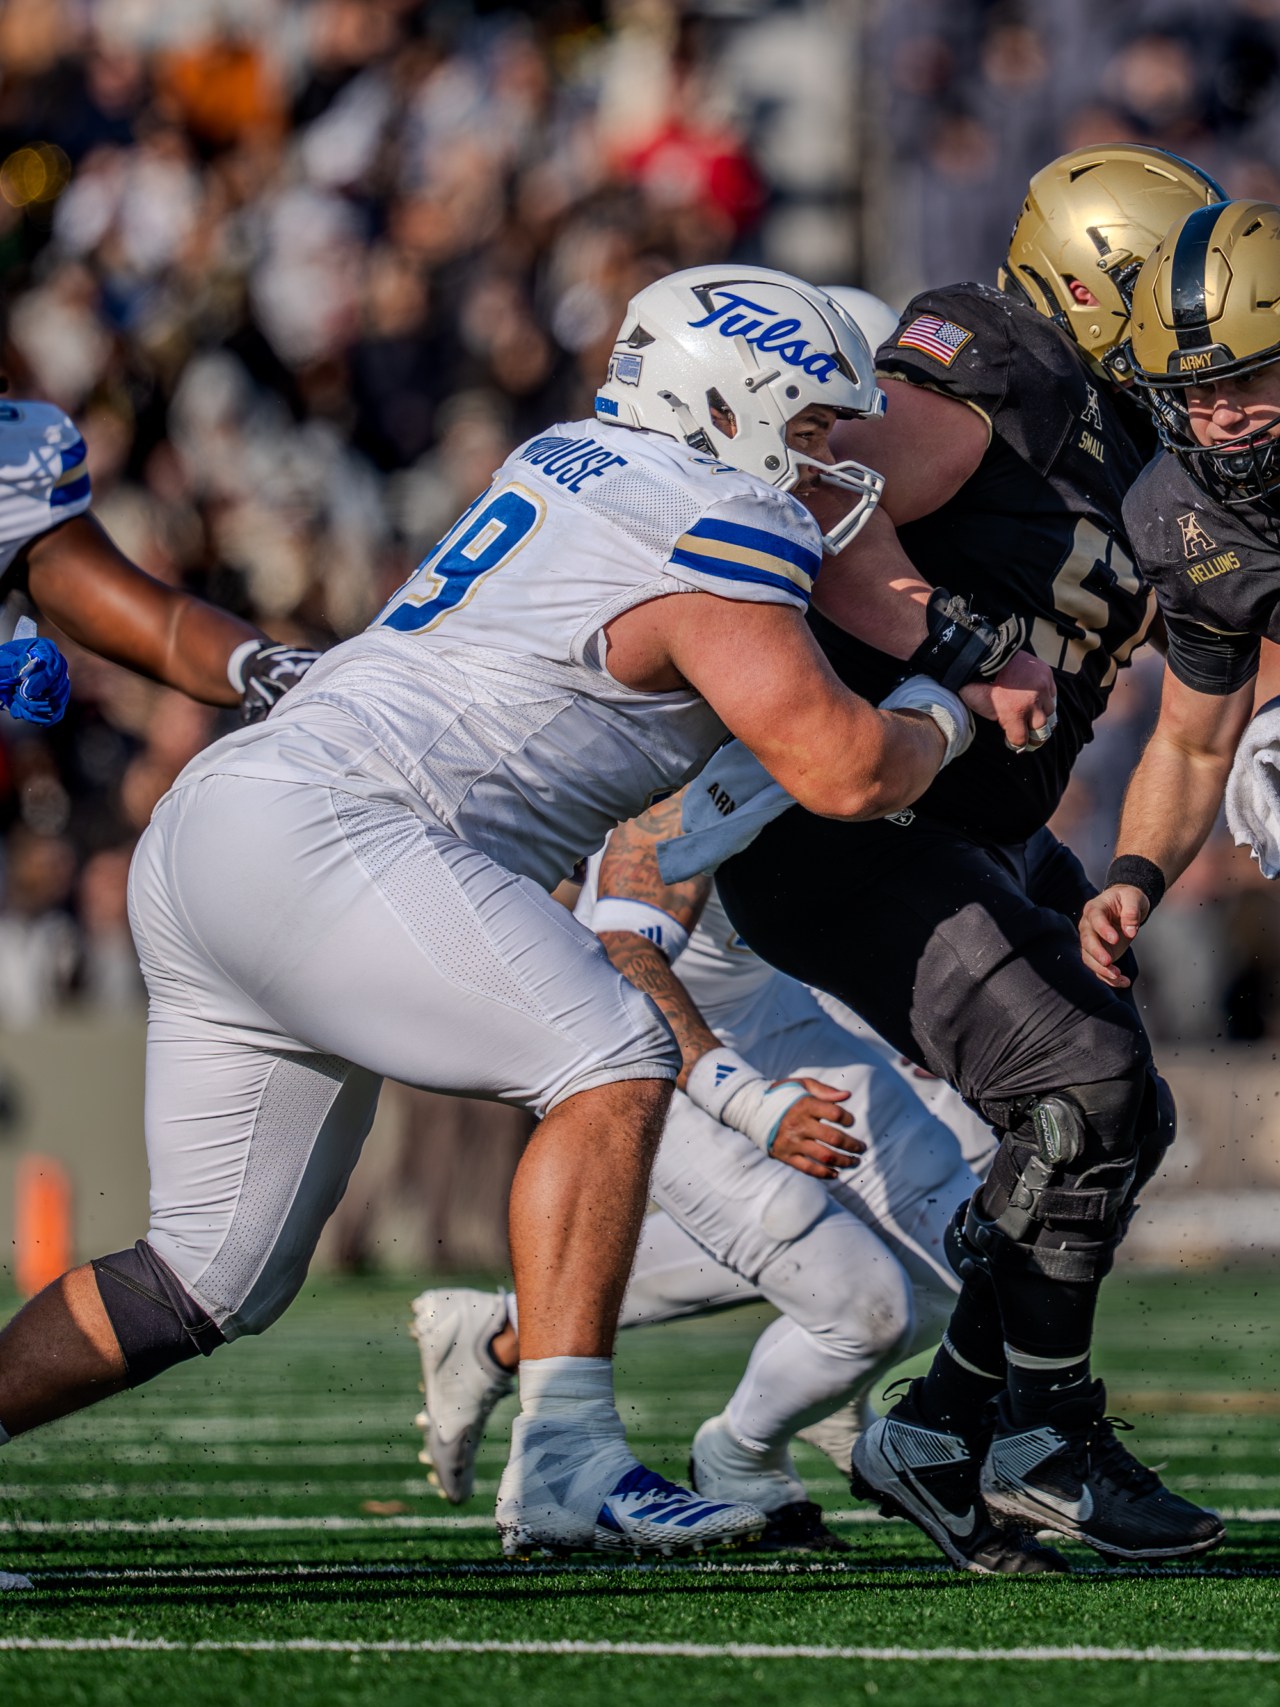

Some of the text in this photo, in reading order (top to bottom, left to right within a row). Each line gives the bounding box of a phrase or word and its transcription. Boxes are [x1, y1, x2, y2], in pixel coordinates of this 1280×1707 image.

[686, 291, 839, 385] Tulsa
[1179, 352, 1214, 372] ARMY
[1078, 430, 1105, 464] SMALL
[1186, 550, 1242, 586] HELLUMS
[1039, 1109, 1056, 1160] DONJOY
